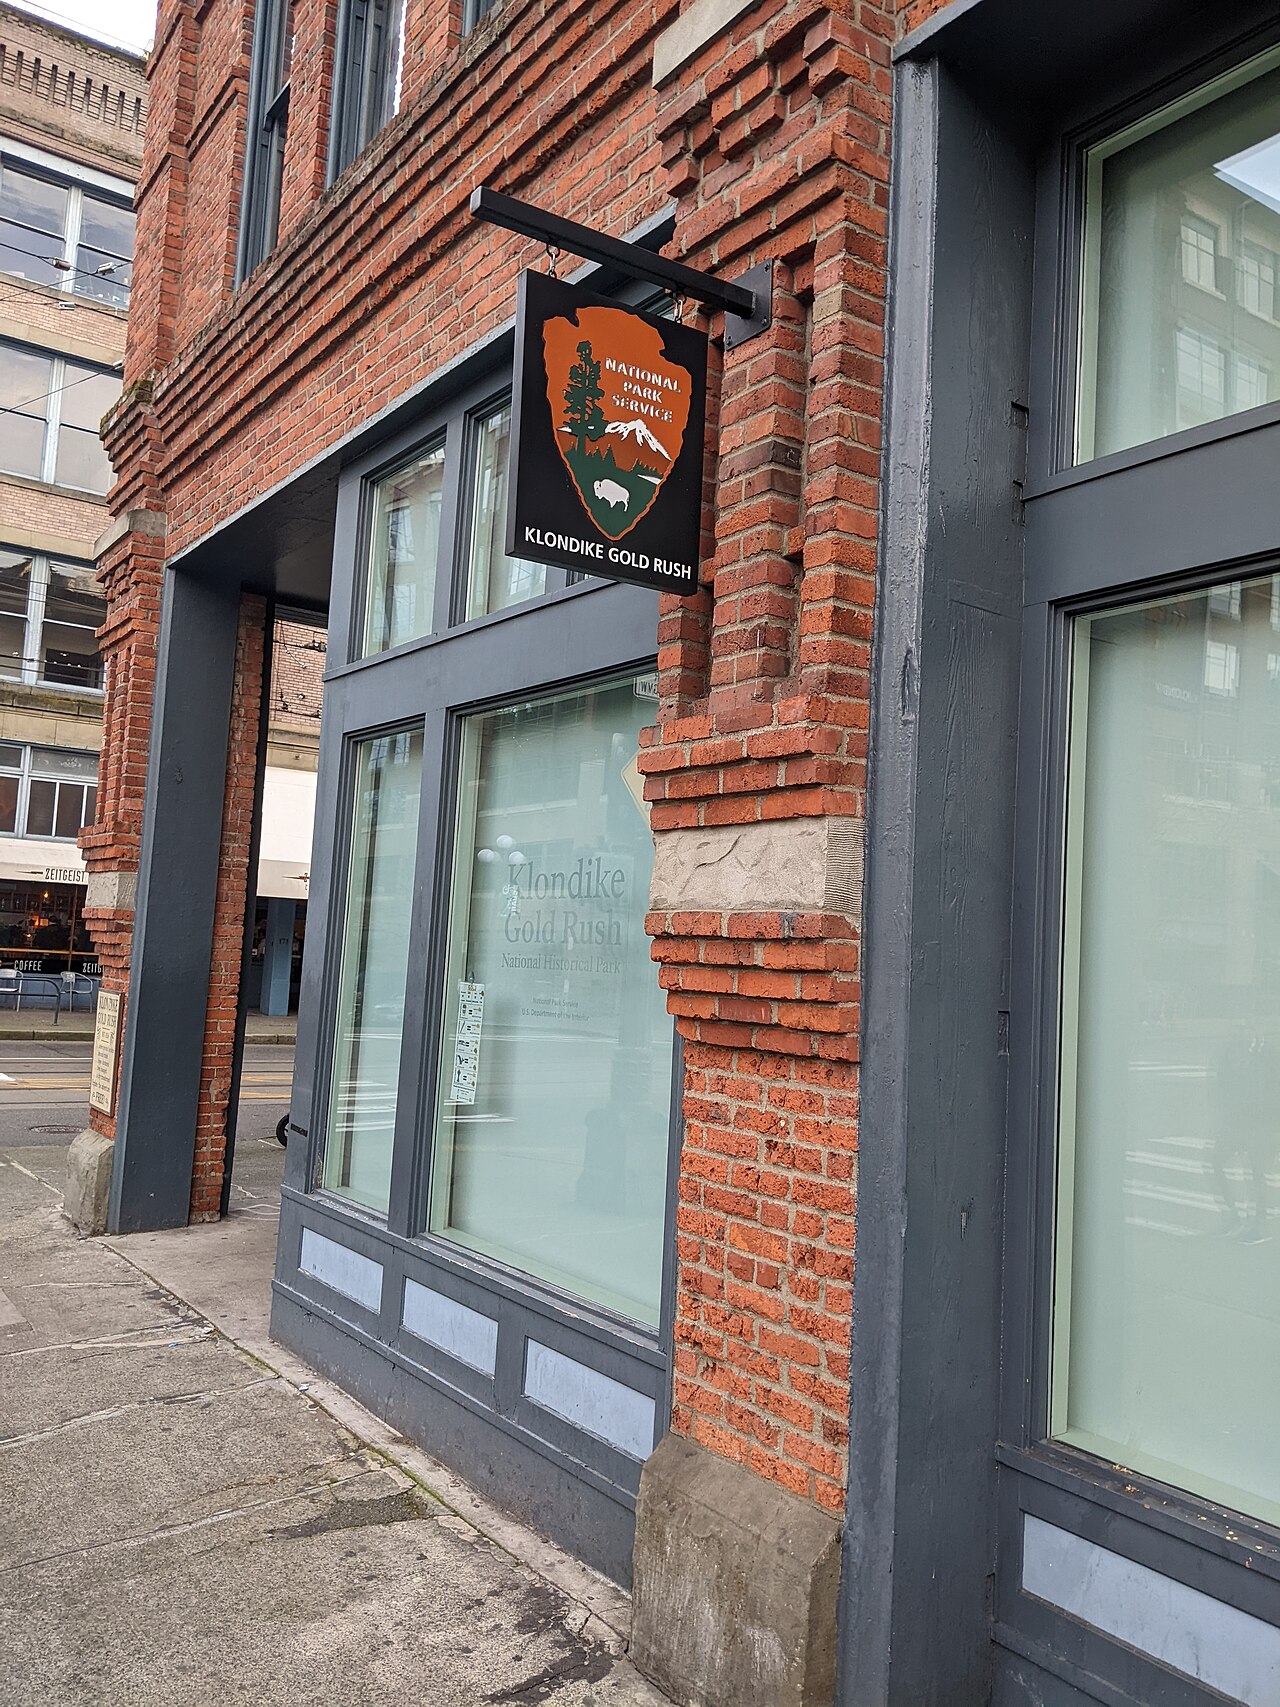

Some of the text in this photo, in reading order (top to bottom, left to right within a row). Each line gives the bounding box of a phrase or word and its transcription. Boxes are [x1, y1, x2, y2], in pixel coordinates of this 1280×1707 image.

[605, 357, 681, 393] NATIONAL
[623, 381, 662, 403] PARK
[612, 393, 673, 423] SERVICE
[524, 526, 692, 580] KLONDIKE GOLD RUSH
[45, 868, 85, 882] ZEITGEIST
[508, 856, 625, 900] Klondike
[504, 909, 622, 945] Gold Rush
[14, 960, 42, 971] COFFEE
[501, 952, 621, 974] National Historical Park
